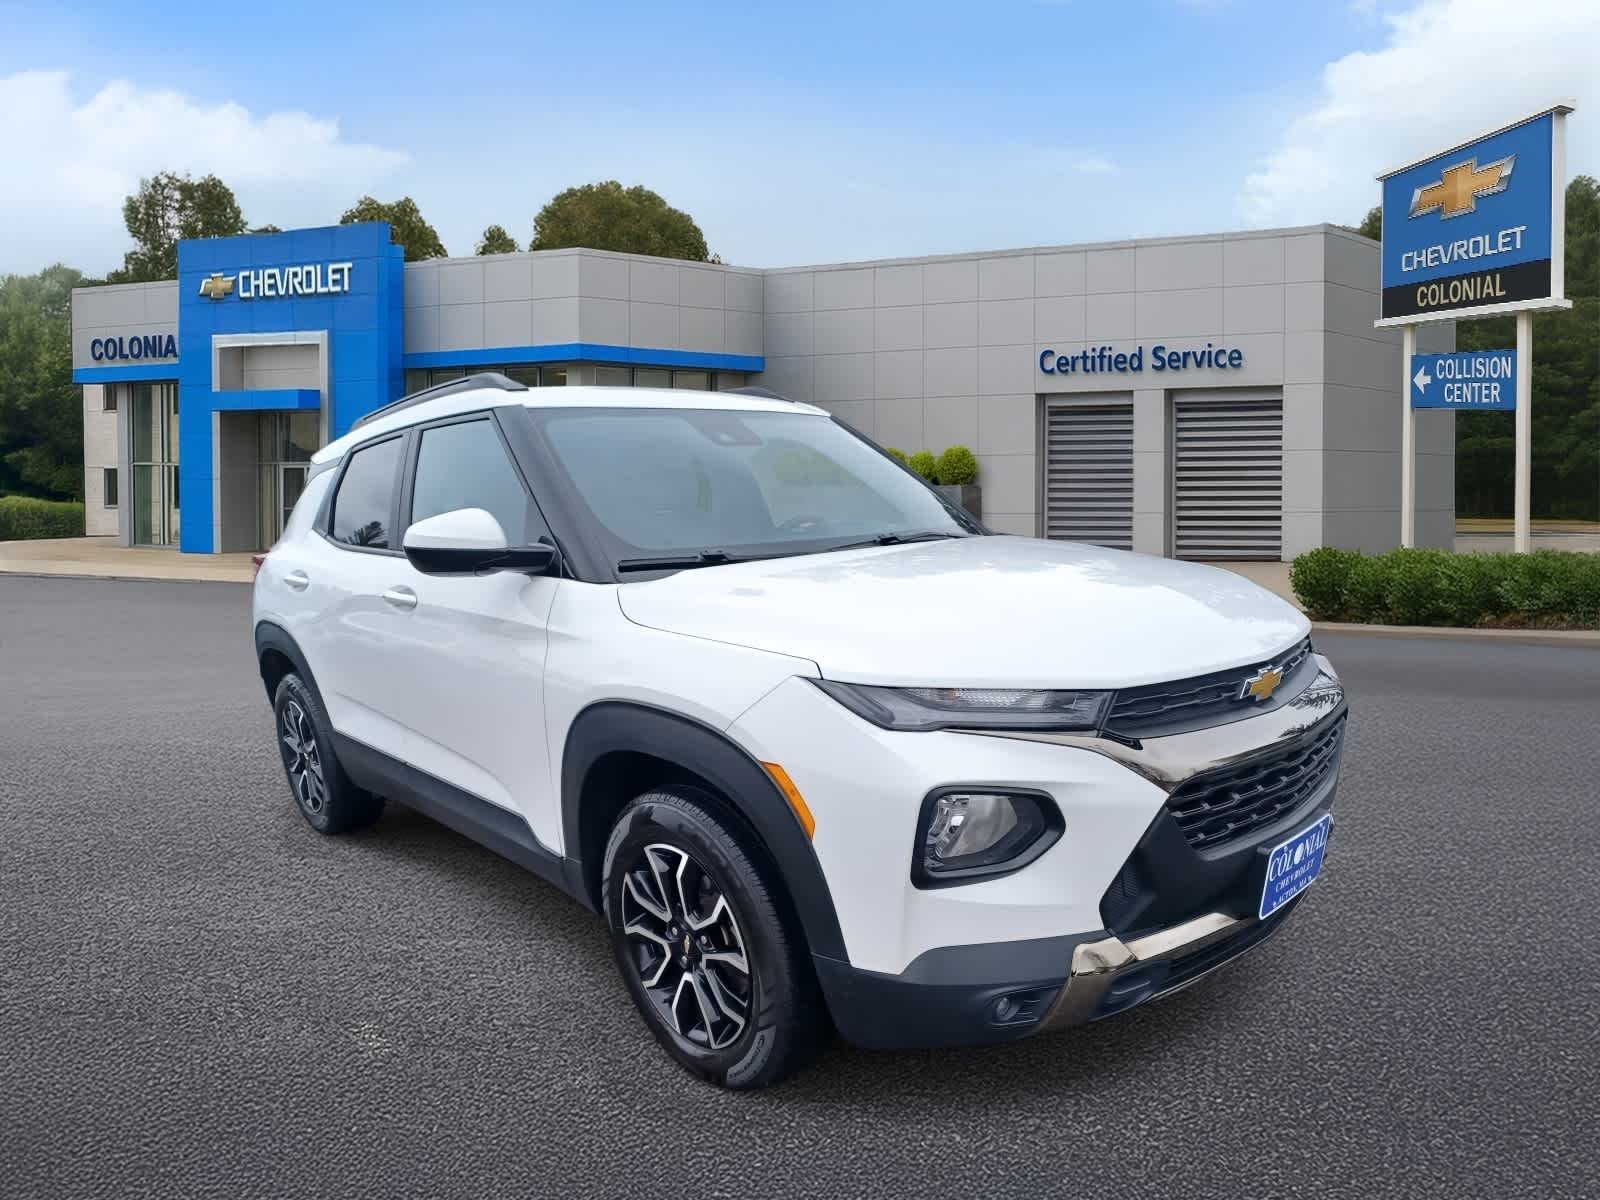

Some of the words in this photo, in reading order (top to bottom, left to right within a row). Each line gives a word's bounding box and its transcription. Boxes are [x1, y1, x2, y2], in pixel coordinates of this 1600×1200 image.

[1401, 225, 1527, 272] CHEVROLET
[238, 262, 352, 298] CHEVROLET
[1416, 273, 1506, 307] COLONIAL
[91, 334, 179, 360] COLONIA
[1040, 346, 1143, 375] Certified
[1151, 343, 1243, 371] Service
[1436, 356, 1512, 379] COLLISION
[1444, 382, 1501, 403] CENTER
[1269, 825, 1325, 882] COLONIAL
[1275, 858, 1314, 892] CHEVROLET
